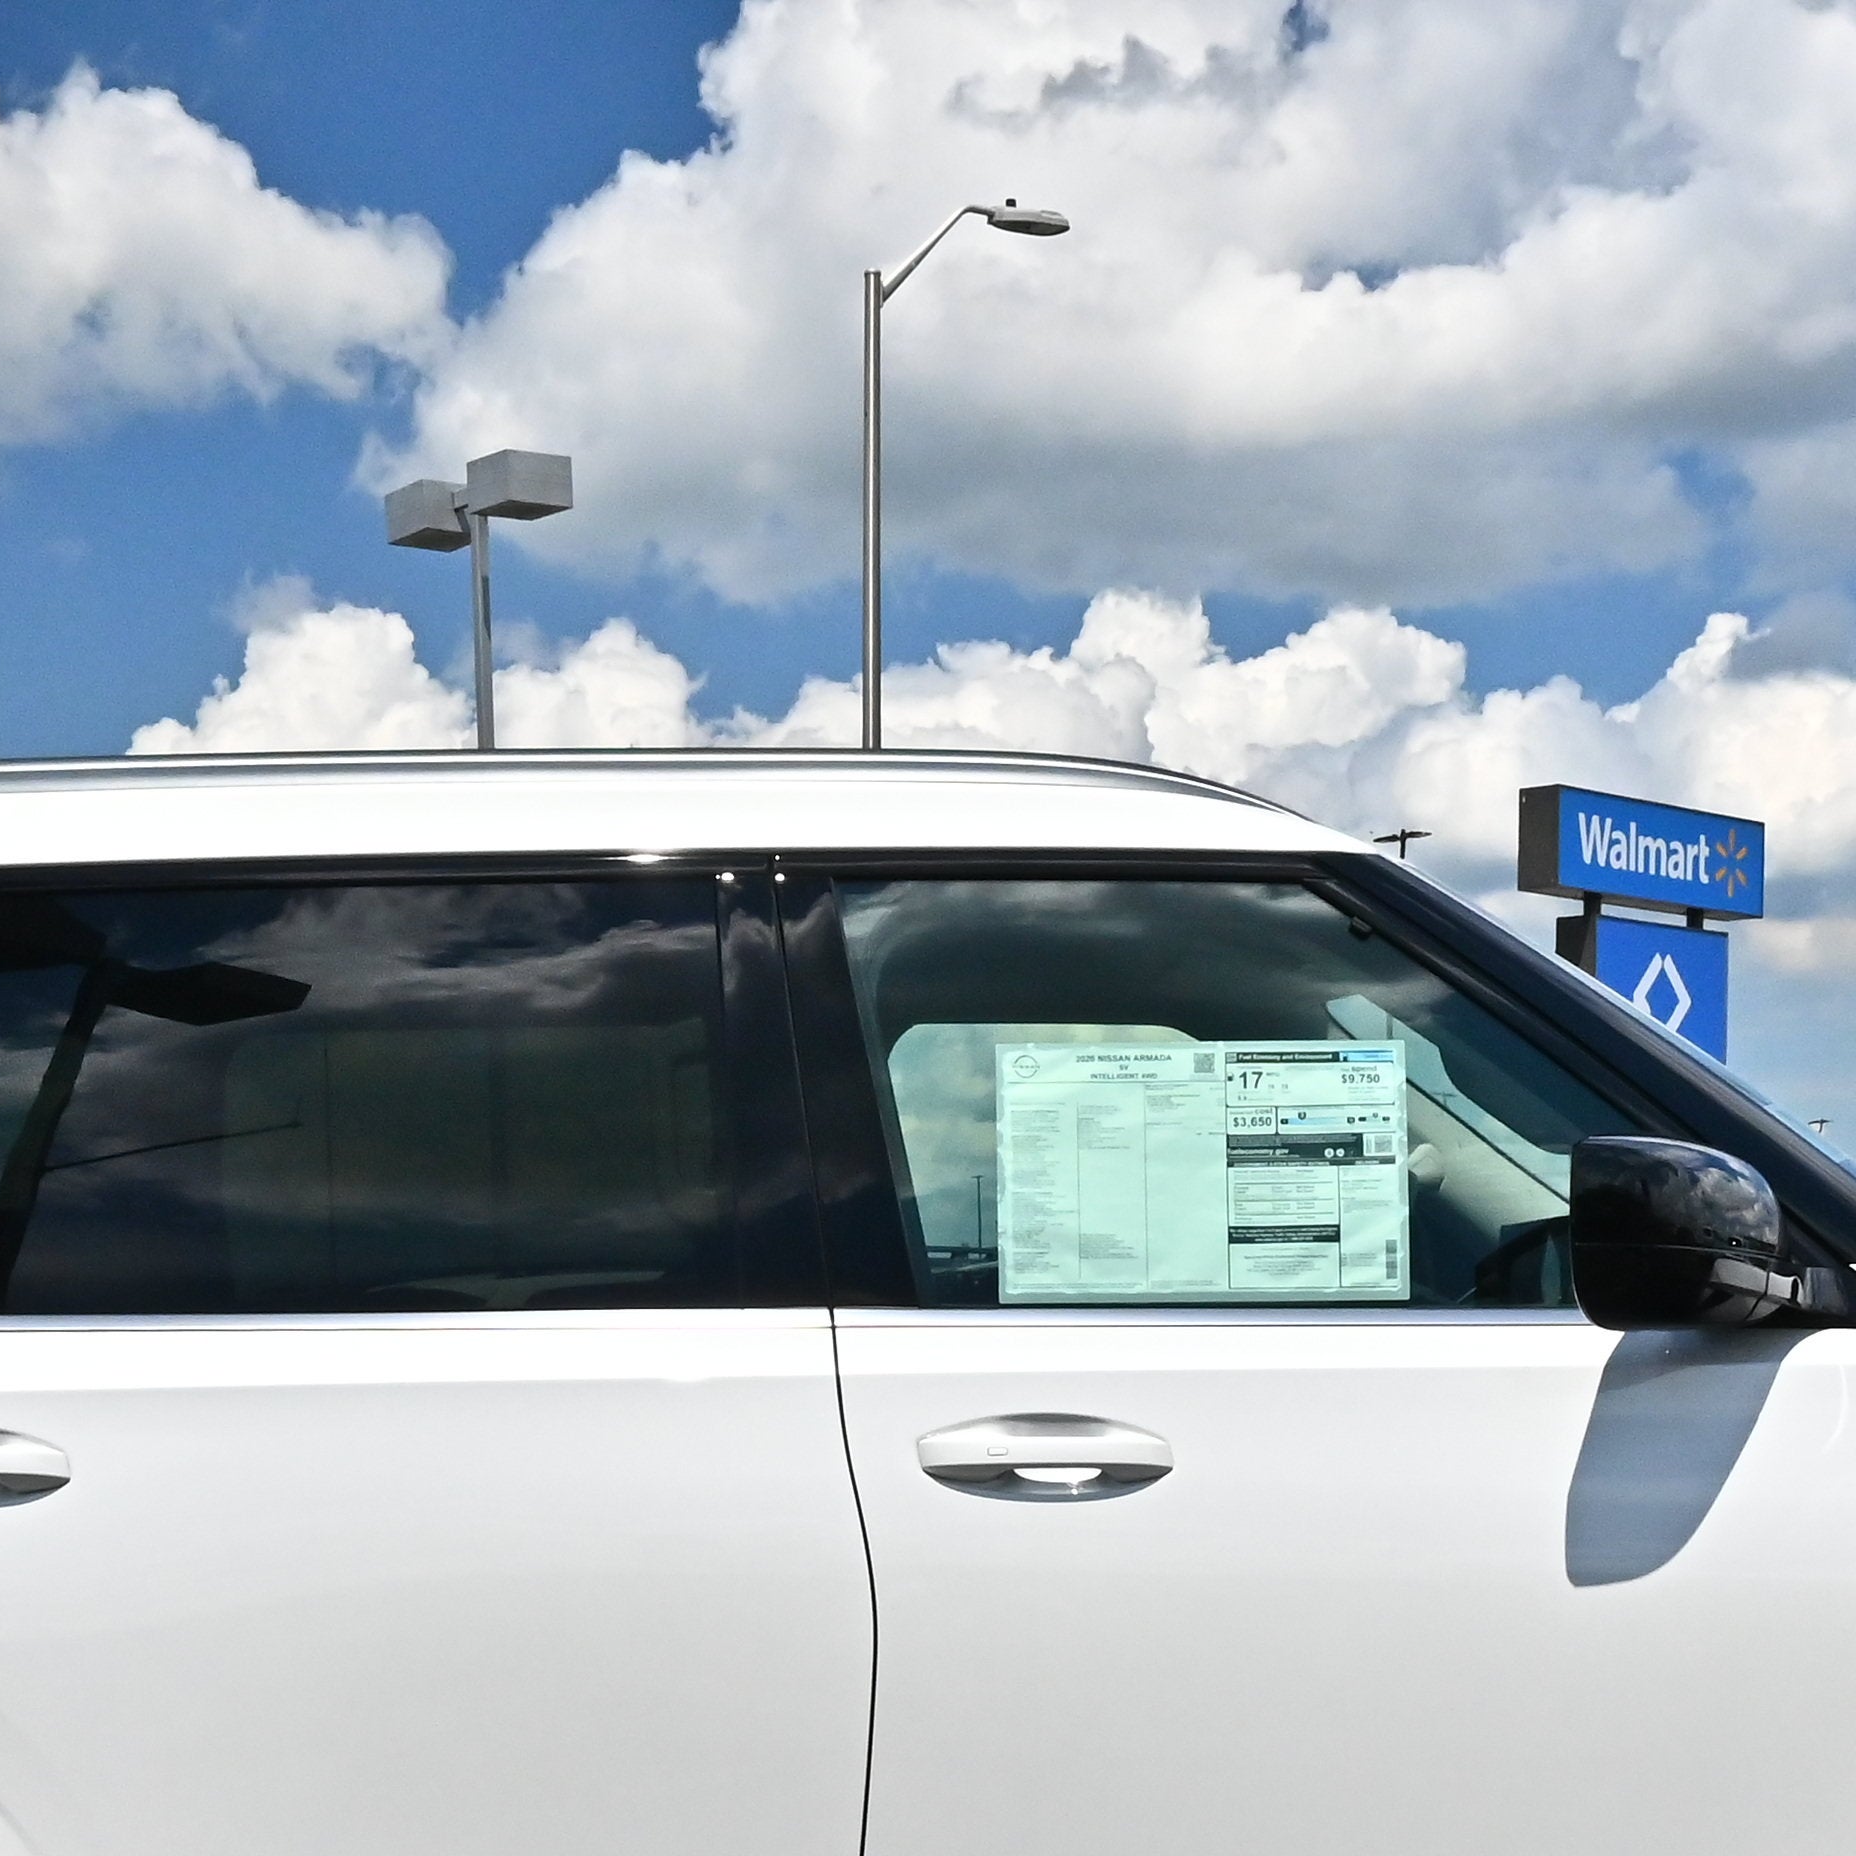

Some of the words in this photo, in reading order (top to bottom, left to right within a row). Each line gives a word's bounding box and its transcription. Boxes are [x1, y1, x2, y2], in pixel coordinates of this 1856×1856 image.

[1578, 812, 1710, 884] Walmart
[1097, 1054, 1131, 1062] NISSAN
[1239, 1071, 1263, 1089] 17
[1341, 1074, 1380, 1084] $9,750
[1233, 1116, 1272, 1128] $3,650
